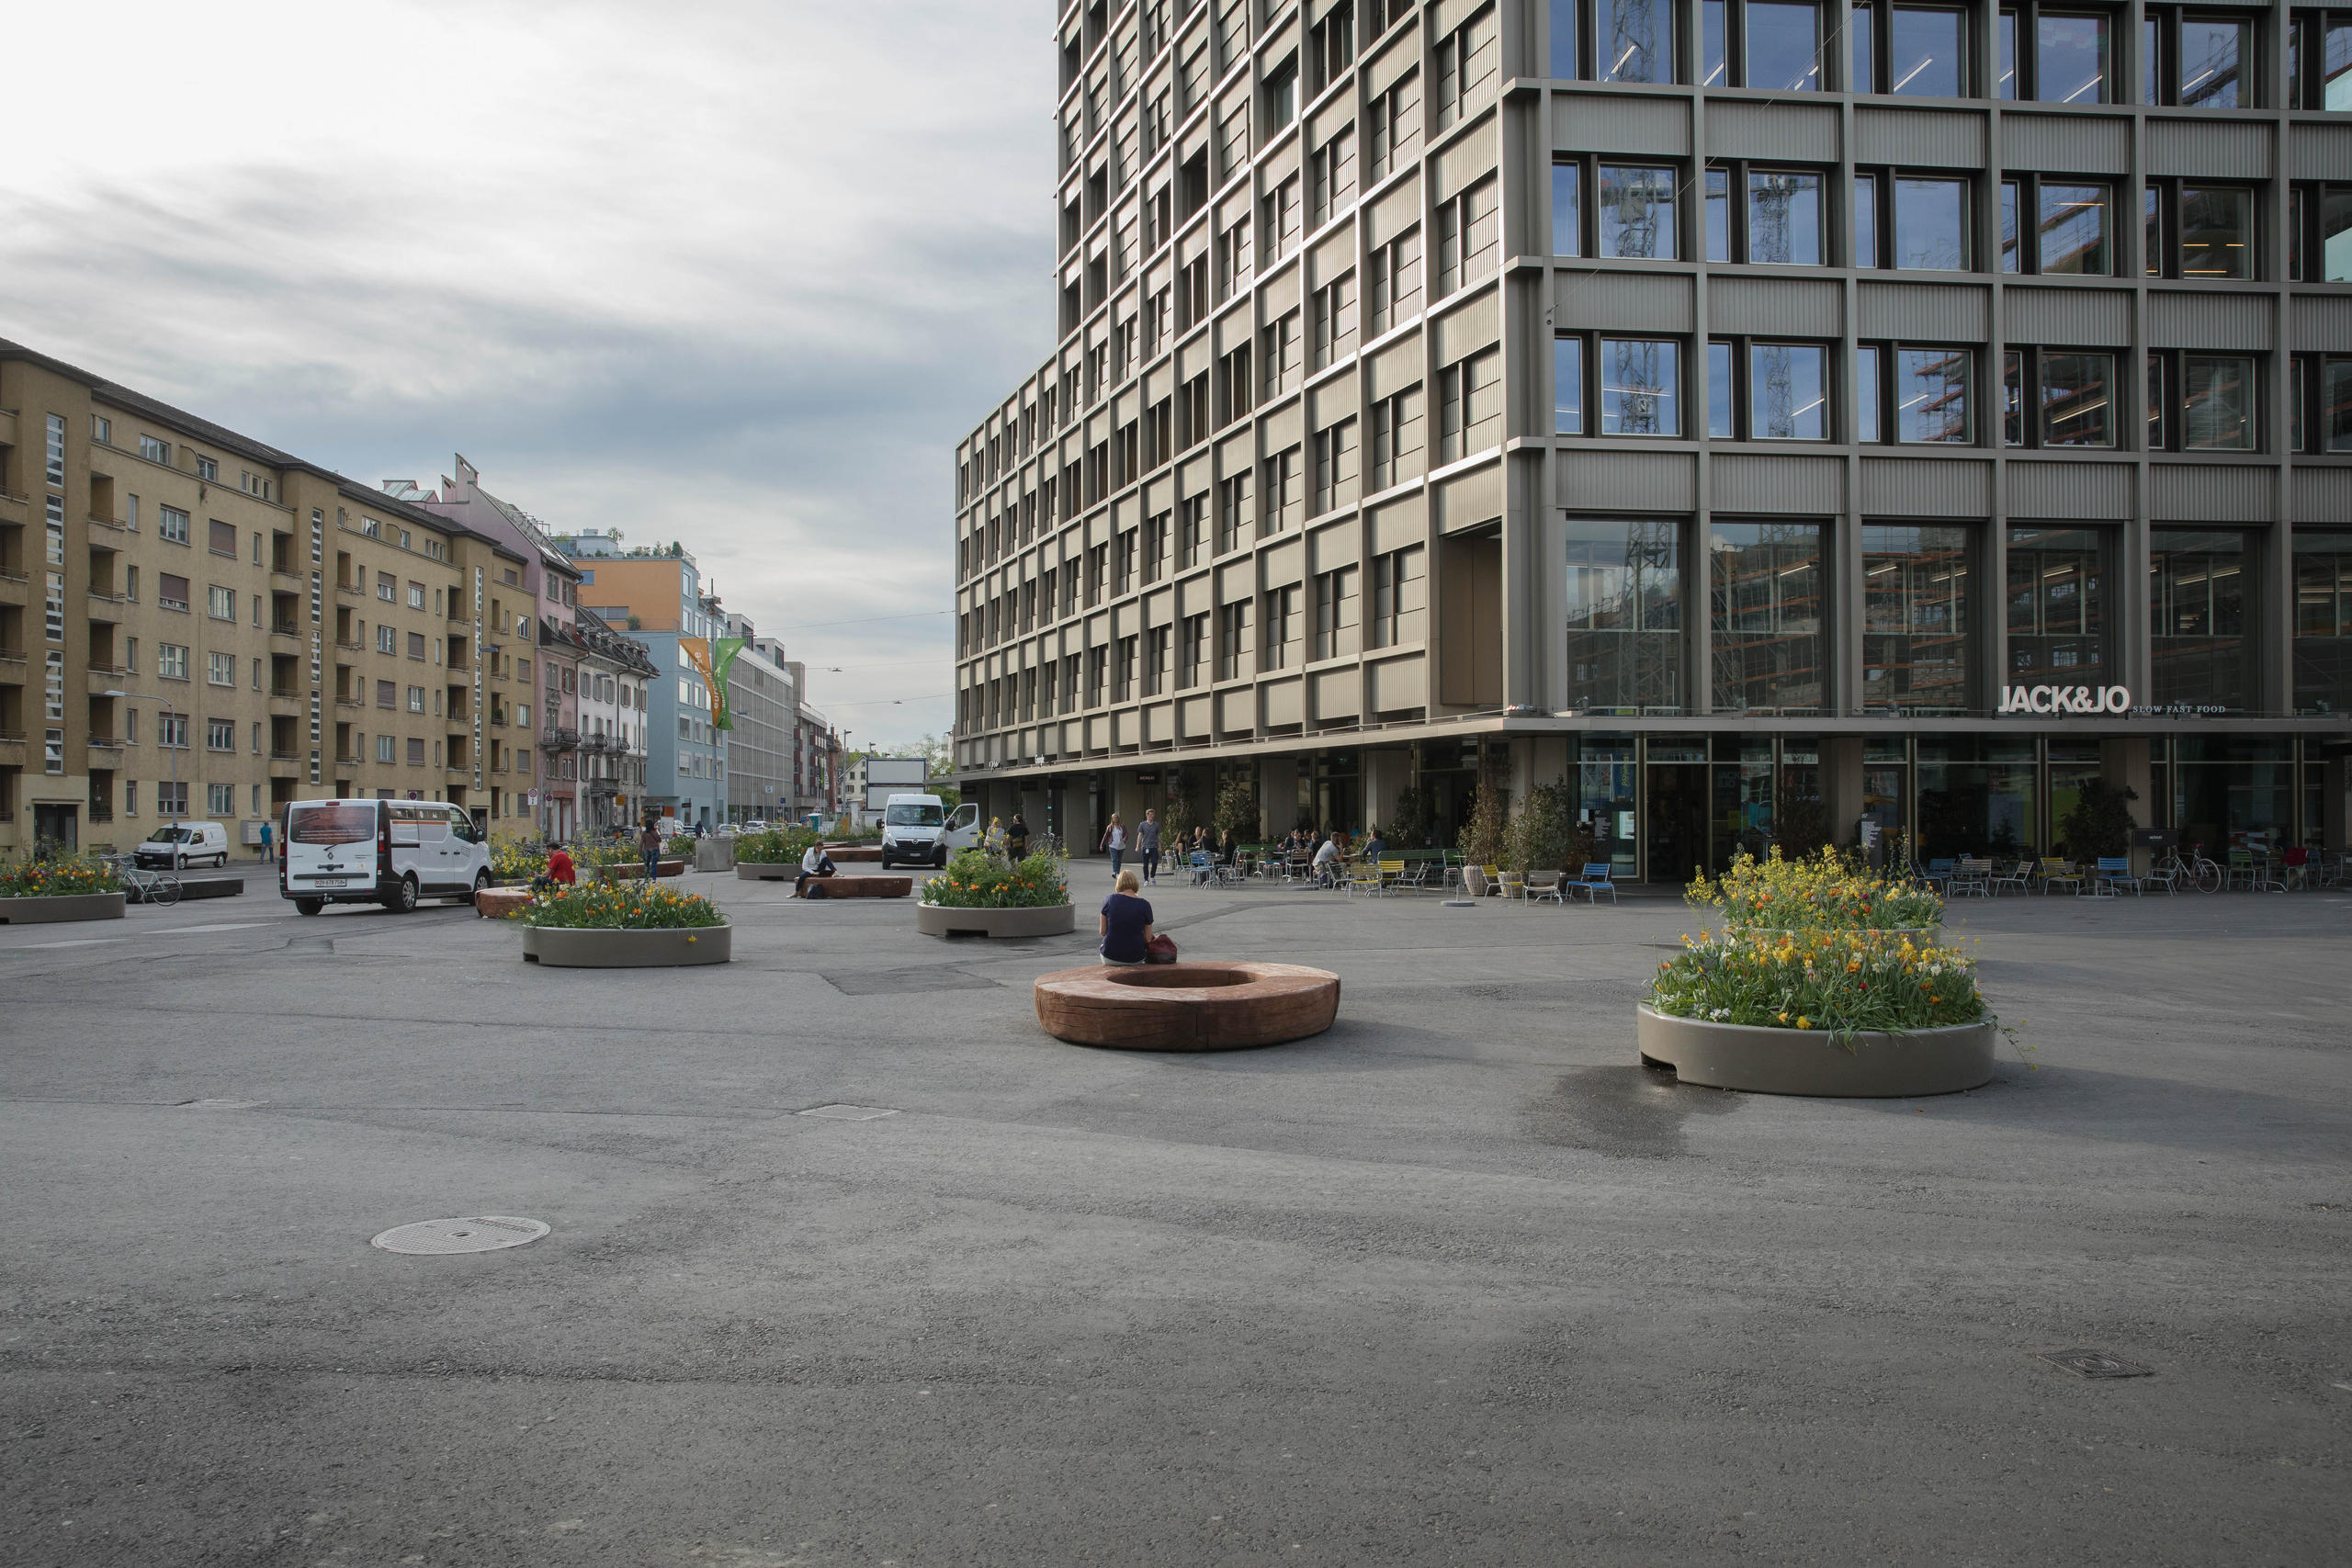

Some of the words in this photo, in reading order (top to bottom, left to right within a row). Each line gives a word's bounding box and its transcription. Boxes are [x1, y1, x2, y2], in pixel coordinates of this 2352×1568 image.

[1997, 685, 2131, 714] JACK&JO
[2132, 705, 2162, 714] SLOW
[2166, 705, 2192, 714] FAST
[2197, 705, 2226, 714] FOOD
